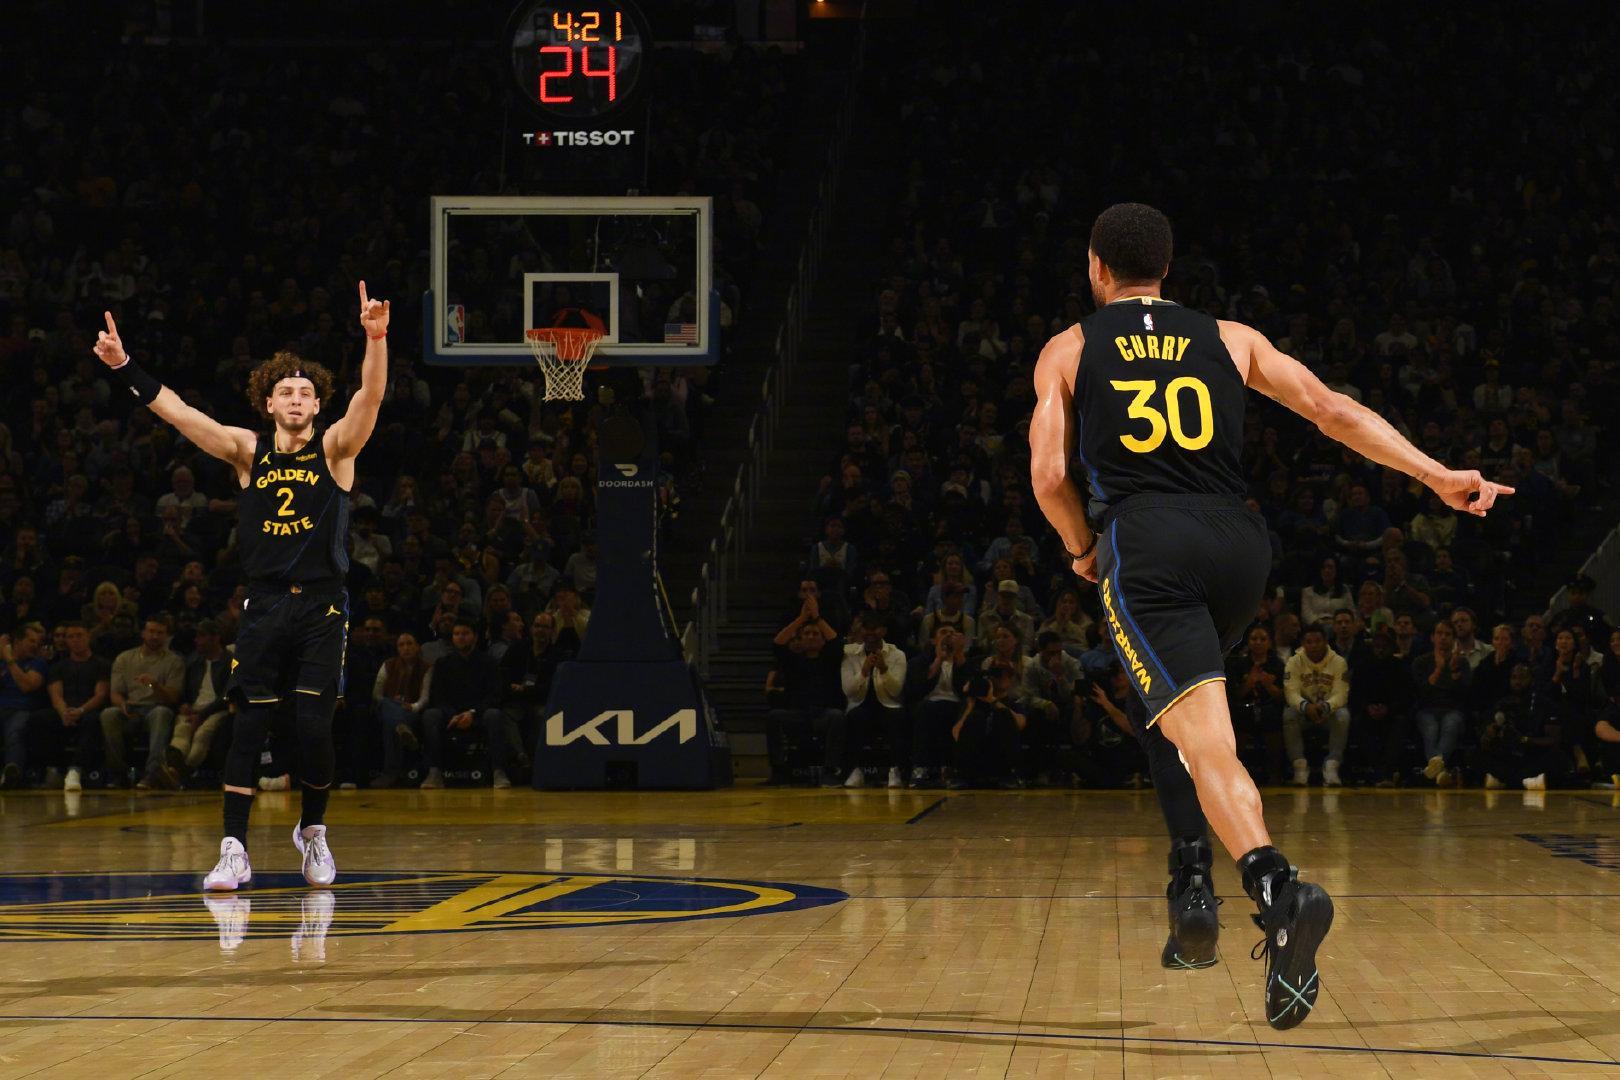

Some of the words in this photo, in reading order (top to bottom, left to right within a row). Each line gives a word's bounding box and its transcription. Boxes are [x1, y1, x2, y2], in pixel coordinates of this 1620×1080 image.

[552, 11, 622, 42] 4:21
[539, 45, 616, 103] 24
[553, 130, 635, 146] TISSOT
[1114, 334, 1191, 362] CURRY
[1109, 376, 1214, 454] 30
[256, 468, 320, 489] GOLDEN
[598, 480, 654, 488] DOORDASH
[276, 486, 296, 517] 2
[262, 515, 314, 536] STATE
[545, 708, 697, 746] KIA
